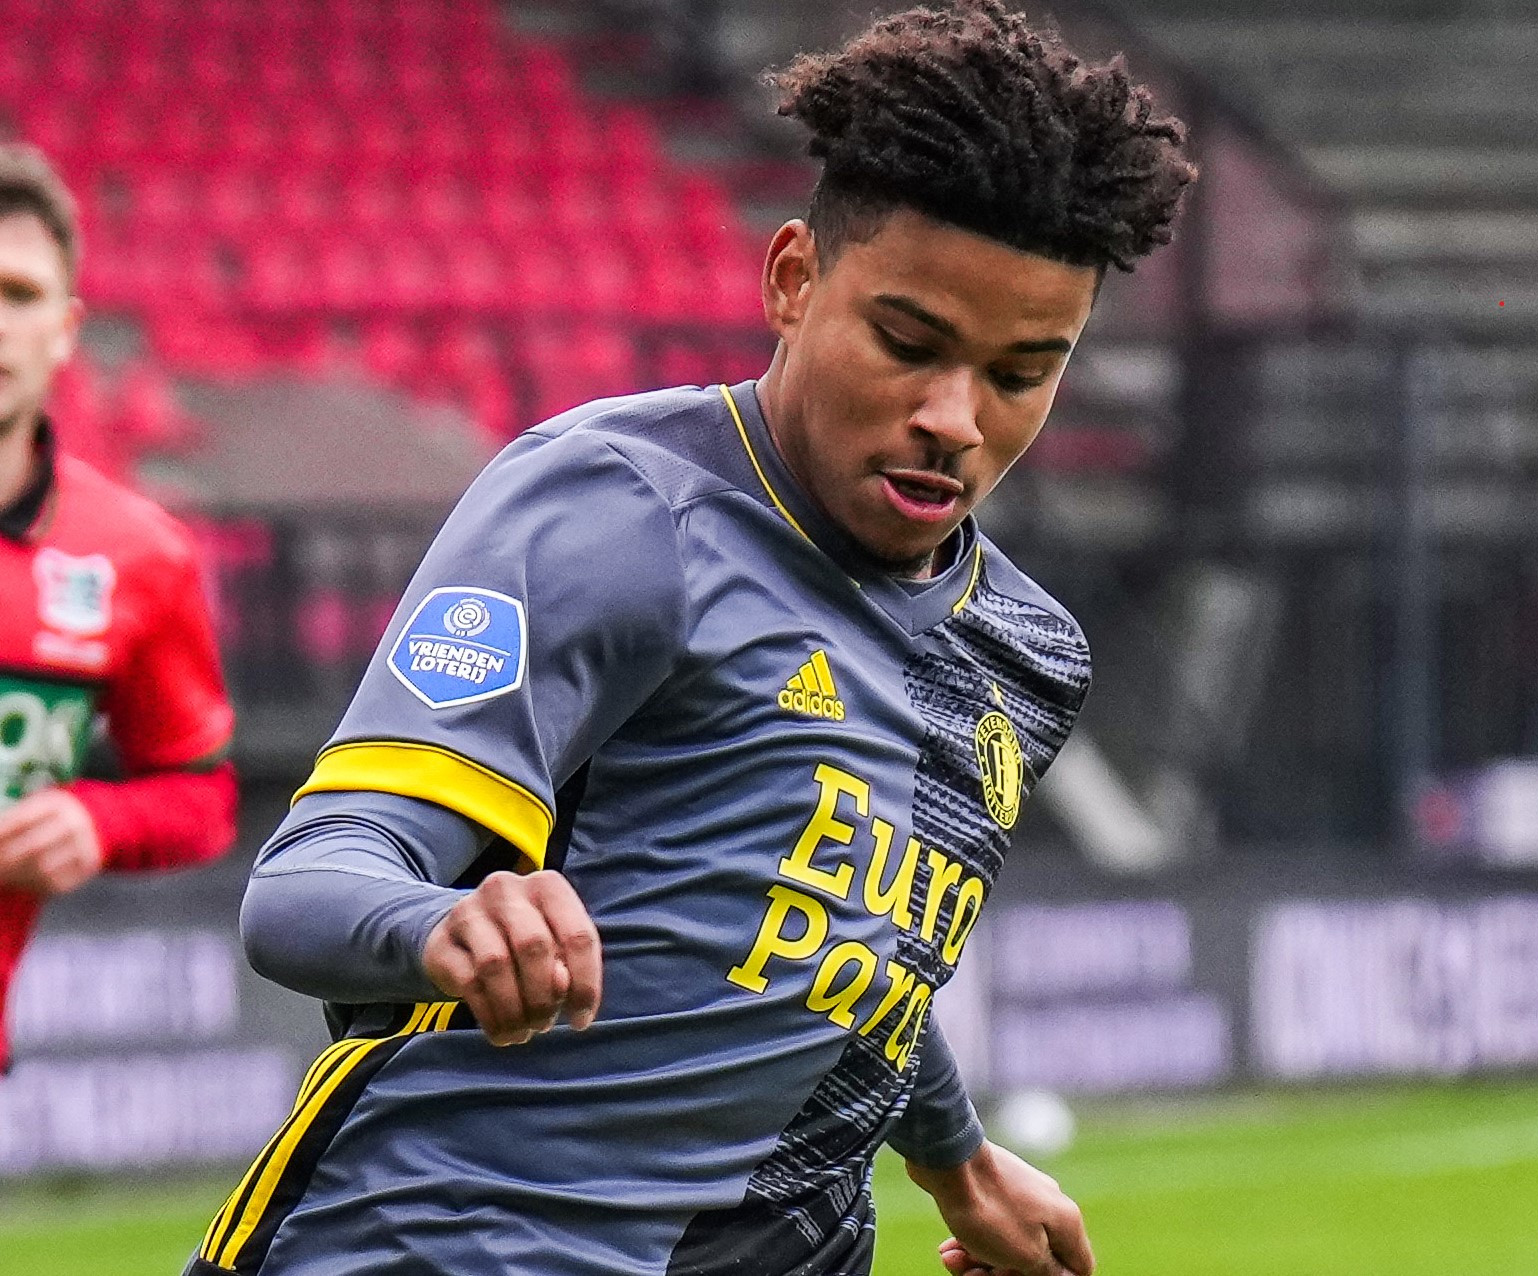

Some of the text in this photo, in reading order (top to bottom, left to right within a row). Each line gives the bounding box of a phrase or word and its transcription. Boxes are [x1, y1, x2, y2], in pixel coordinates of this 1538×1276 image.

[409, 640, 504, 673] VRIENDEN
[410, 656, 487, 684] LOTERIJ
[777, 689, 845, 721] adidas
[778, 762, 984, 966] Euro
